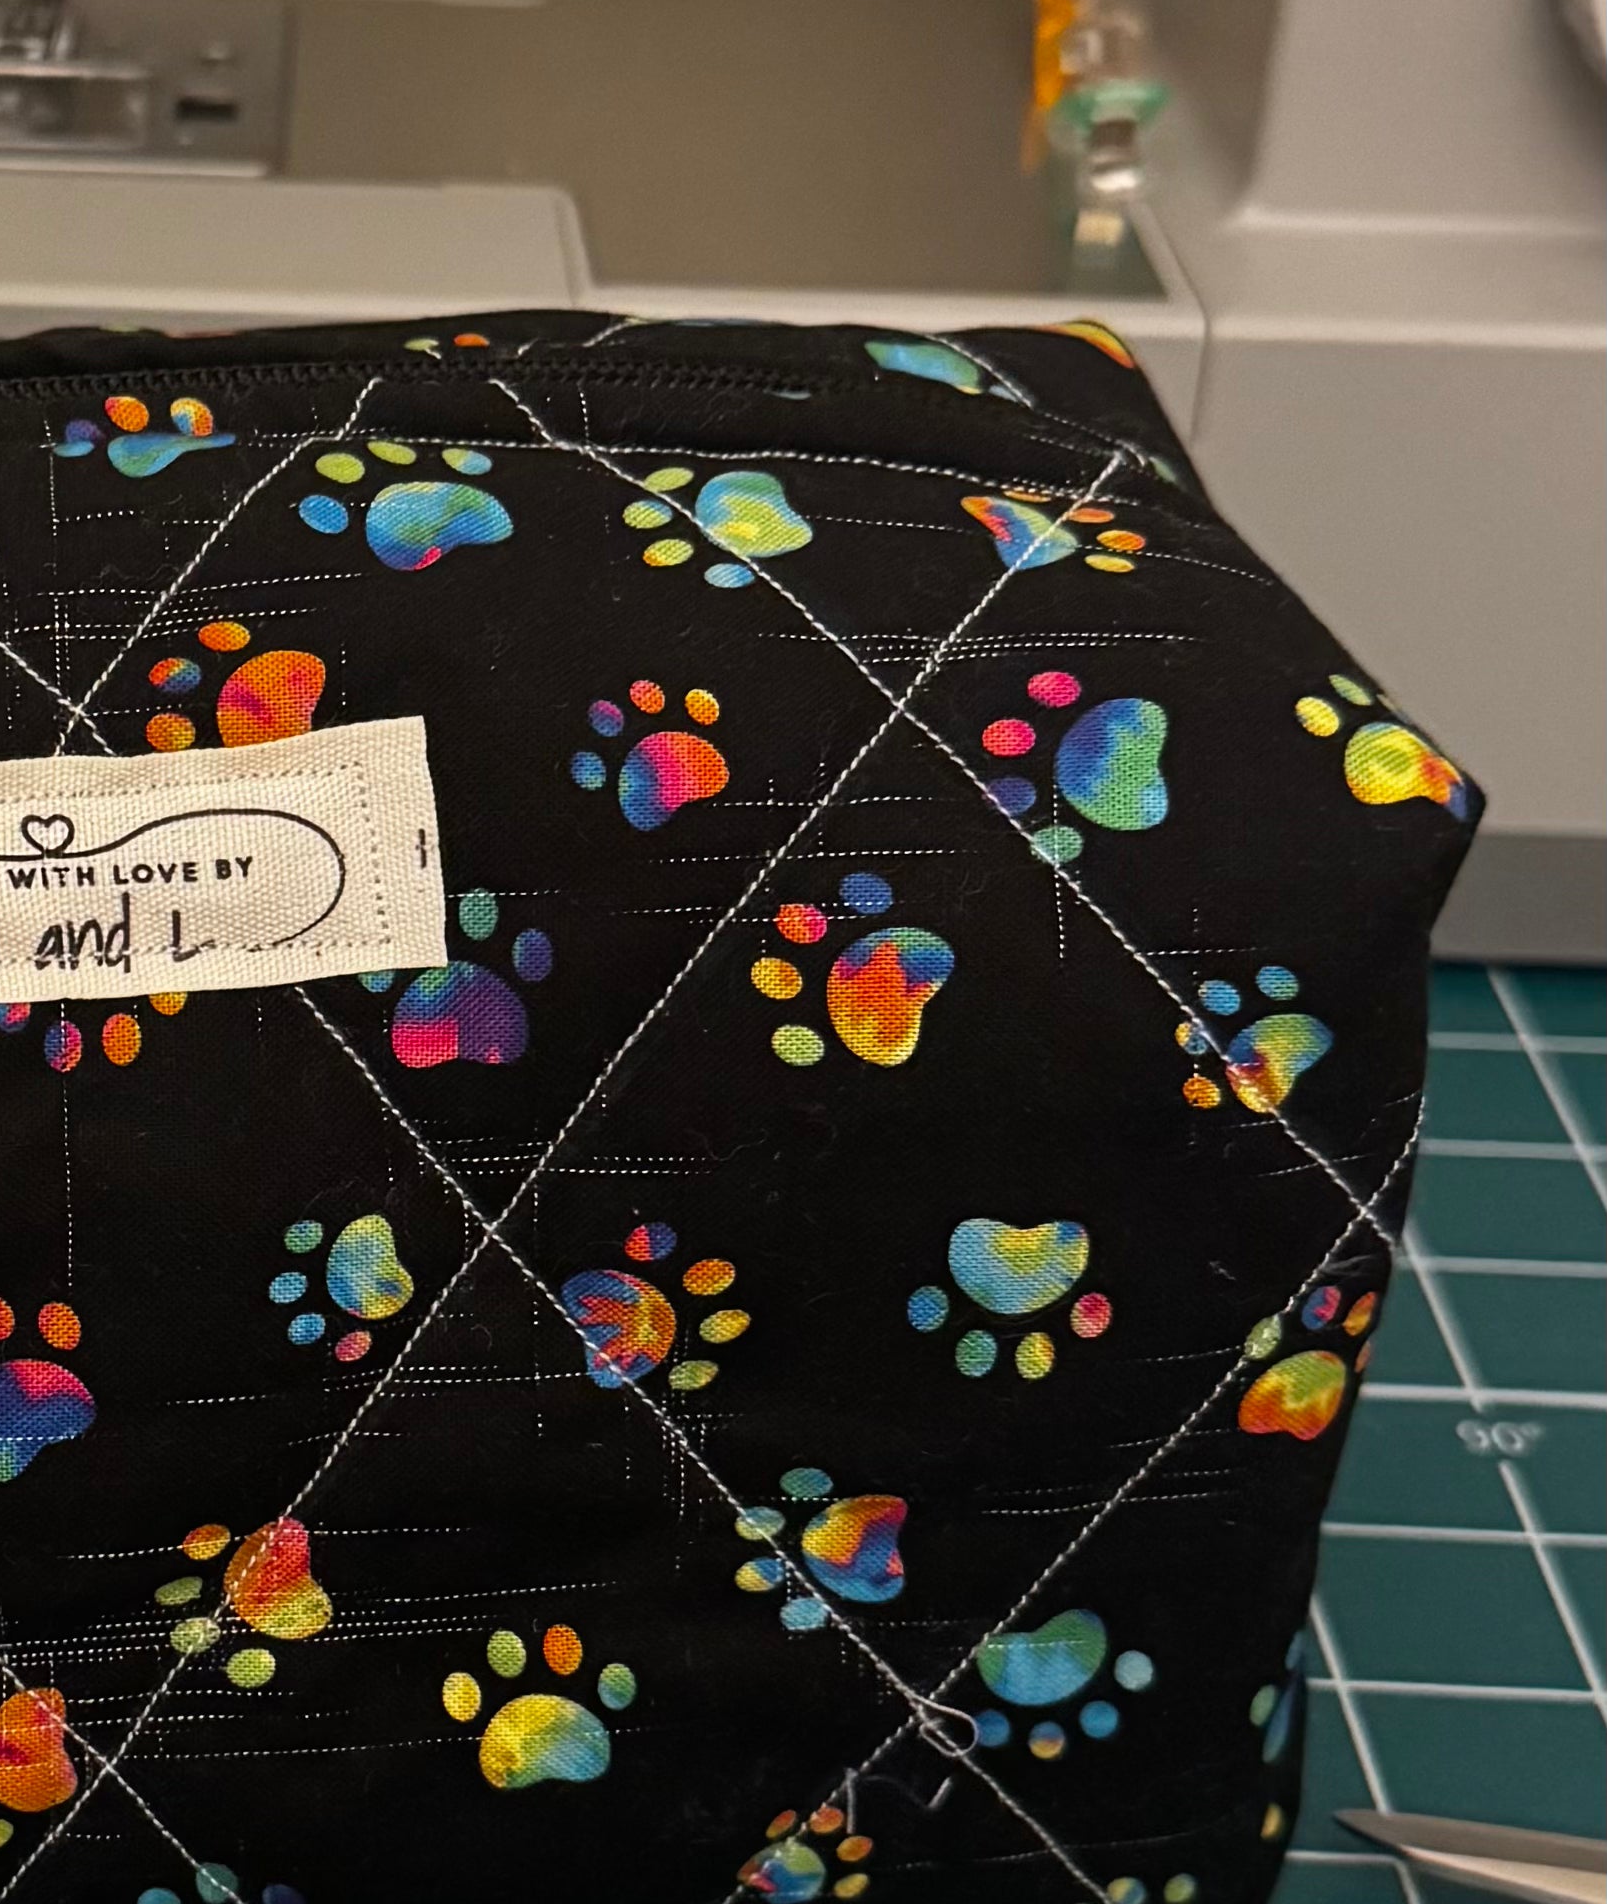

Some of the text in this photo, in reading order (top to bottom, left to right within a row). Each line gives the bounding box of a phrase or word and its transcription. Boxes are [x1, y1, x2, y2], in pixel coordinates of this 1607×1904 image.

[6, 865, 95, 891] WITH
[112, 862, 199, 886] LOVE
[214, 855, 254, 881] BY
[33, 891, 132, 974] and
[169, 909, 204, 963] L
